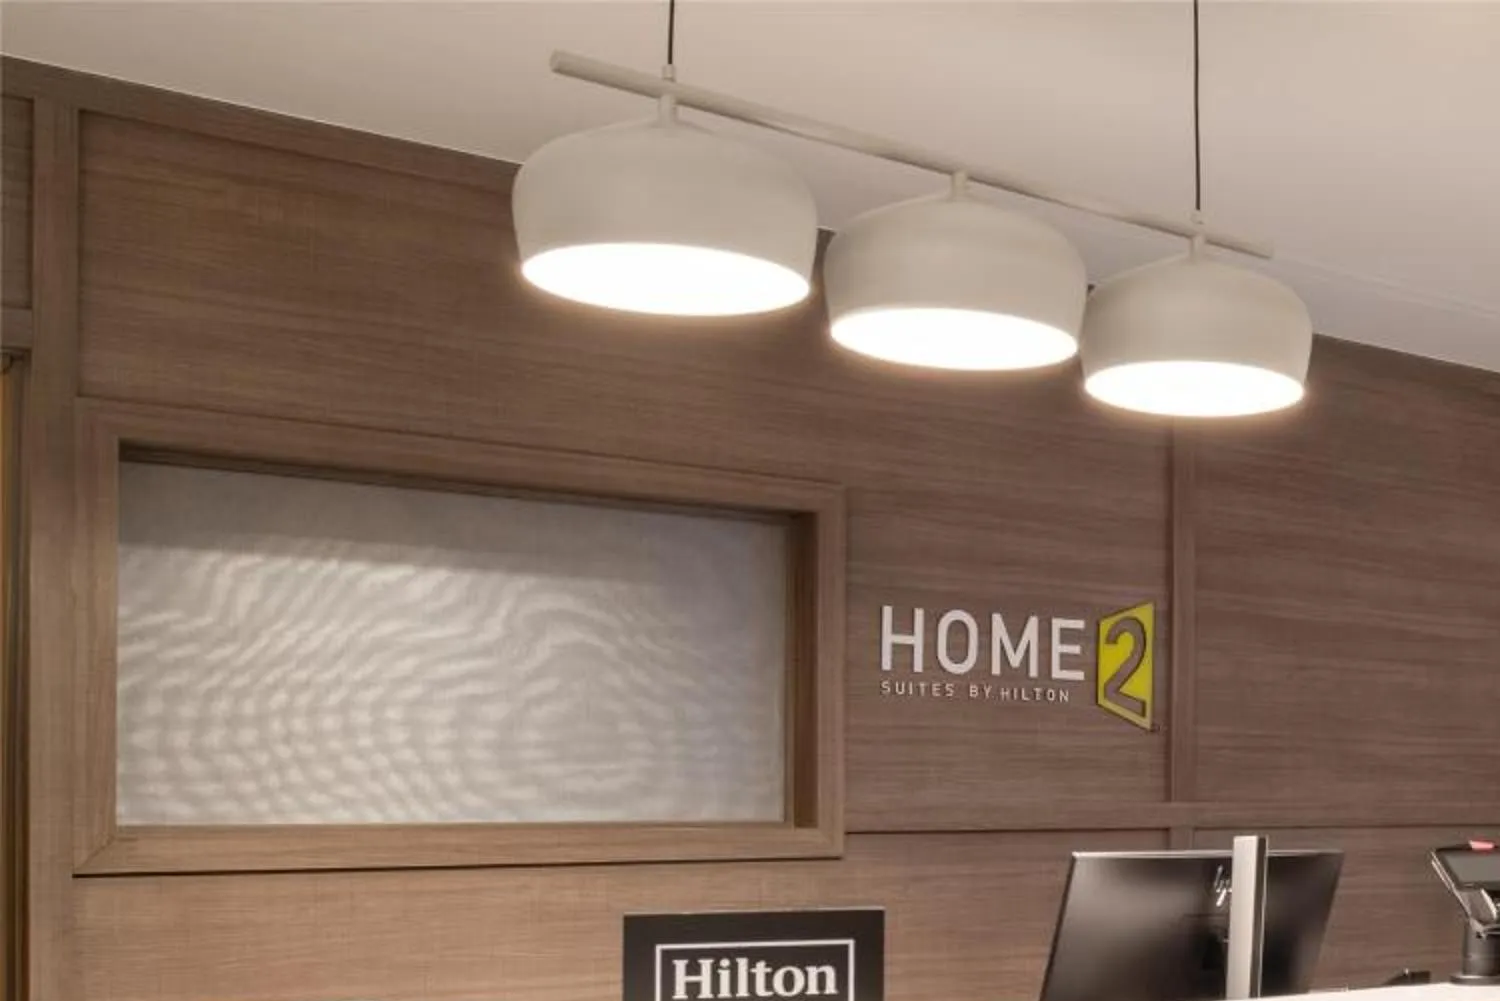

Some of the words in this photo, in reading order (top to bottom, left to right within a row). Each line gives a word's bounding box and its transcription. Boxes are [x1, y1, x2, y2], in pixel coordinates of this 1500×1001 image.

[880, 604, 1086, 681] HOME
[881, 680, 954, 697] SUITES
[969, 685, 992, 698] BY
[1001, 687, 1069, 702] HILTON
[671, 957, 839, 1000] Hilton
